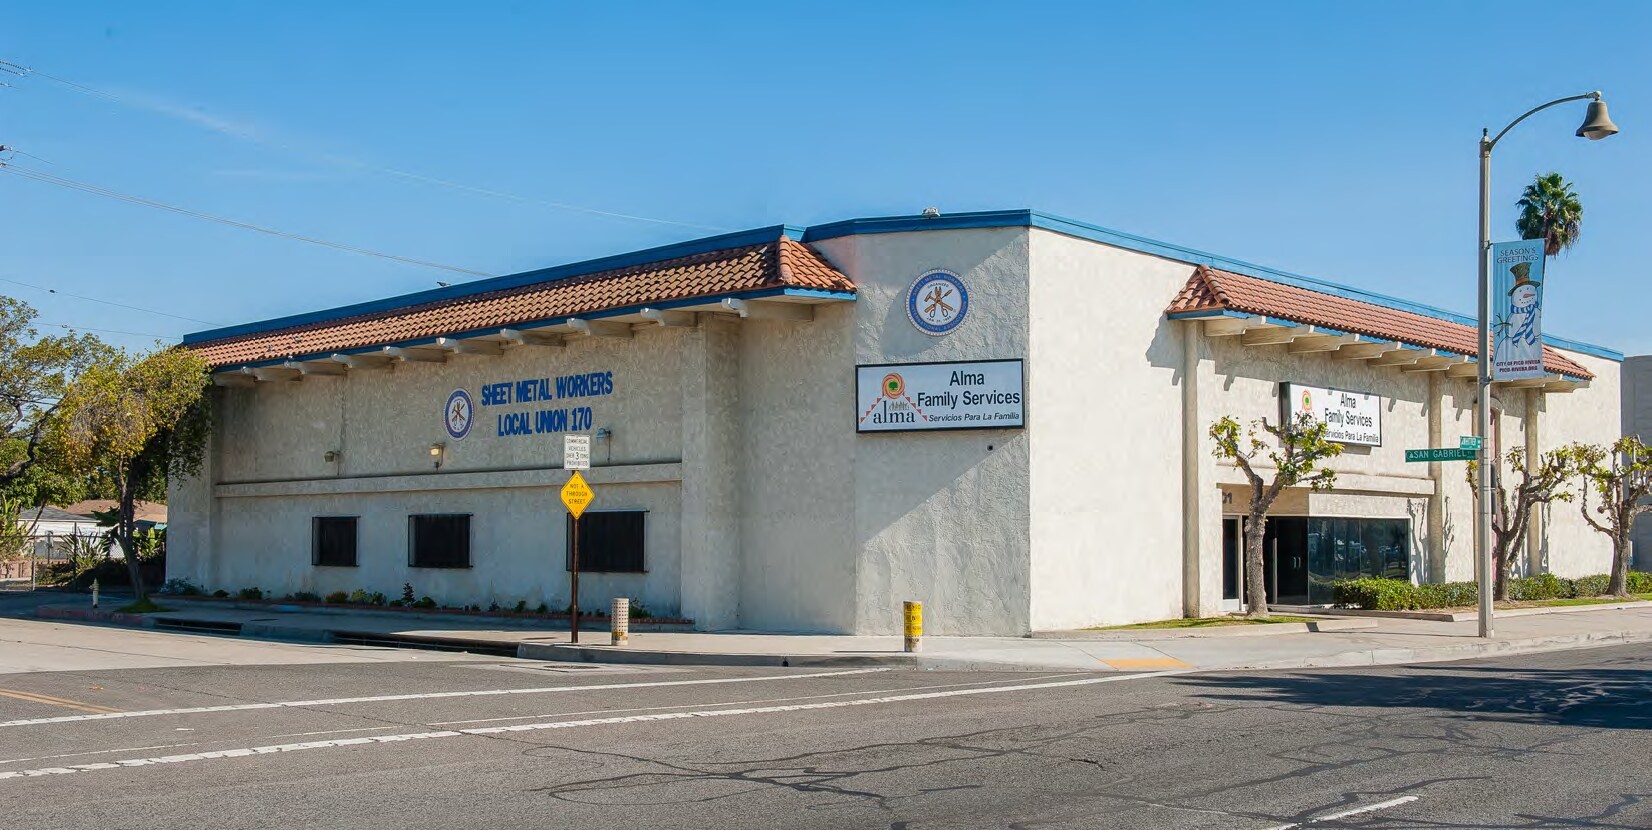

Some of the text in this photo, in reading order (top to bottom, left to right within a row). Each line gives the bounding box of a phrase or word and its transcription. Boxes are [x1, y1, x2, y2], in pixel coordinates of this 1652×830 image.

[1497, 255, 1538, 263] GREETINGS
[950, 371, 984, 386] Alma
[482, 371, 613, 405] SHEET METAL WORKERS
[917, 389, 1020, 410] Family Services
[1340, 393, 1357, 409] Alma
[873, 400, 915, 424] alma
[928, 411, 1020, 423] Servicios Para La Familia
[1324, 407, 1373, 428] Family Services
[498, 412, 532, 436] LOCAL
[535, 408, 568, 434] UNION
[572, 407, 592, 431] 170
[1324, 428, 1379, 443] ervicios Para La Familia
[575, 451, 580, 461] 3
[1413, 450, 1429, 459] SAN
[1432, 449, 1467, 458] GABRIEL
